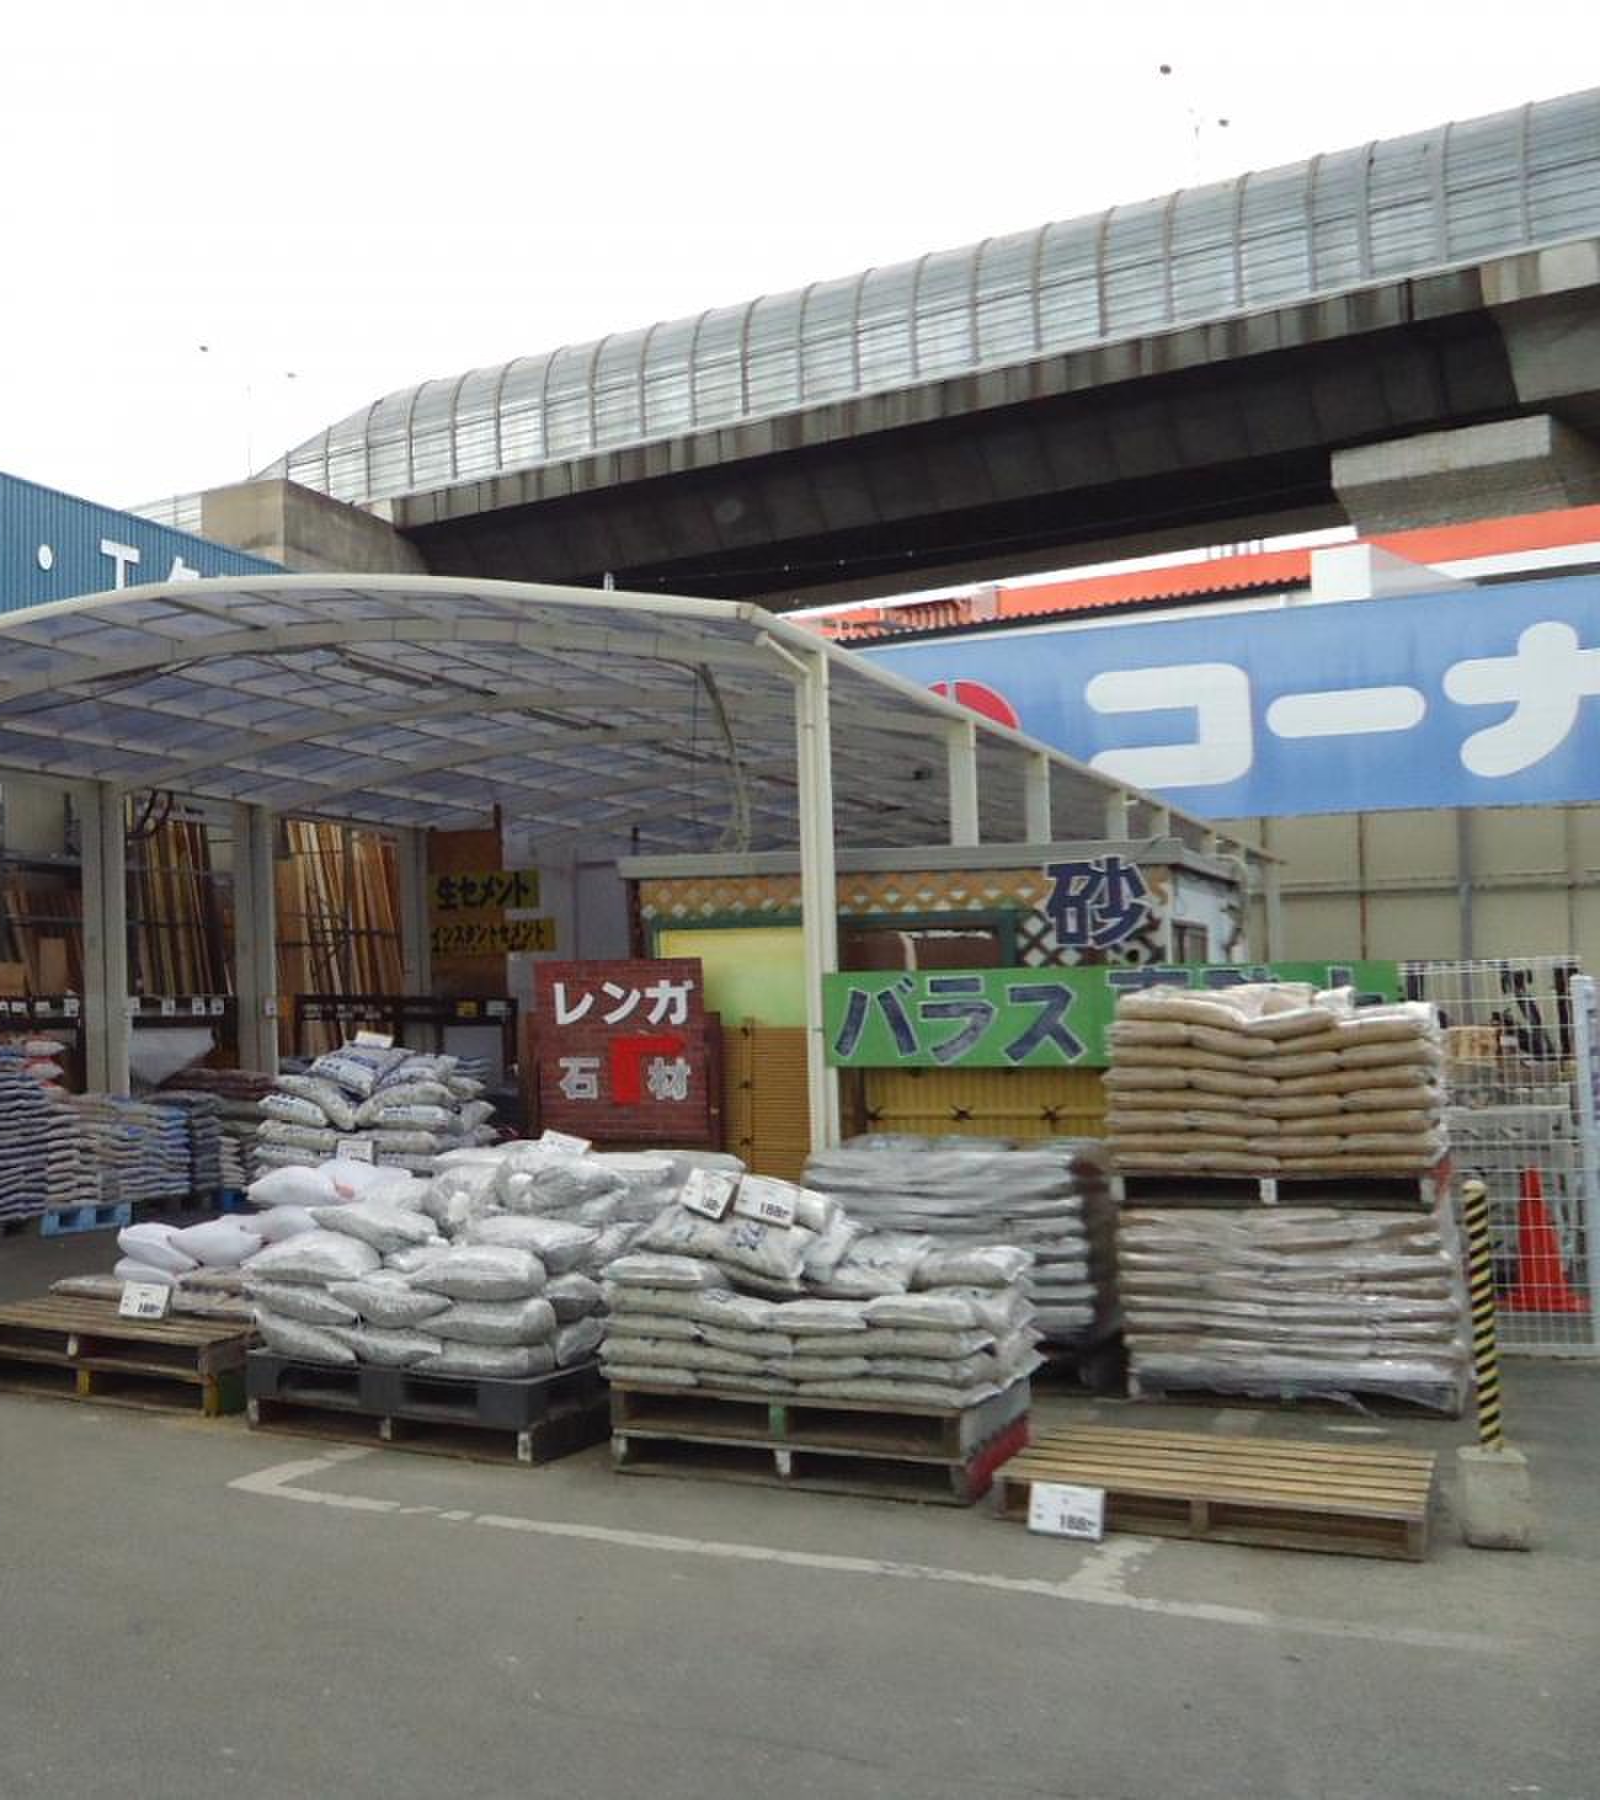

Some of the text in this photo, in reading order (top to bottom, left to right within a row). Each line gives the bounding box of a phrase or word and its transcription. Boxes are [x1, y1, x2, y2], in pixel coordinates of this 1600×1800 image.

[436, 871, 530, 911] 生セメント
[1043, 852, 1152, 948] 砂
[553, 979, 694, 1025] レンガ
[833, 975, 1092, 1066] バラス
[558, 1056, 692, 1101] 石材
